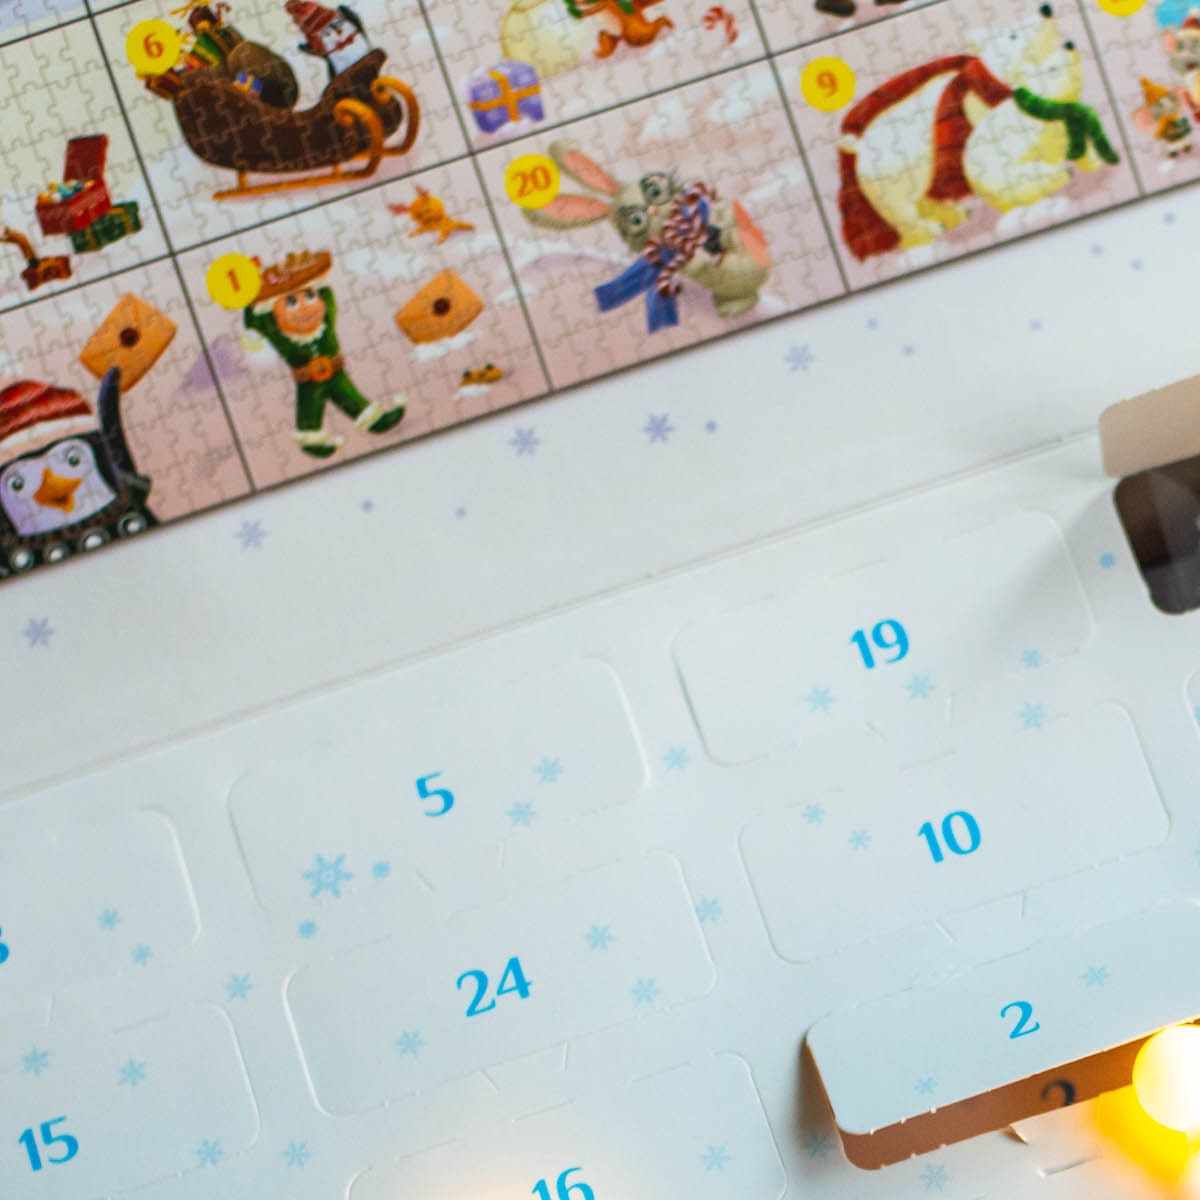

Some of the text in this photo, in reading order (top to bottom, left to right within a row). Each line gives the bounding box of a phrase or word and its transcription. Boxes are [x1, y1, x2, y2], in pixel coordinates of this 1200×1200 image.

[143, 32, 165, 59] 6
[815, 70, 838, 98] 9
[511, 164, 553, 199] 20
[225, 268, 241, 294] 1
[850, 618, 910, 670] 19
[415, 773, 455, 817] 5
[917, 810, 982, 864] 10
[456, 956, 532, 1018] 24
[999, 1000, 1041, 1040] 2
[17, 1116, 79, 1172] 15
